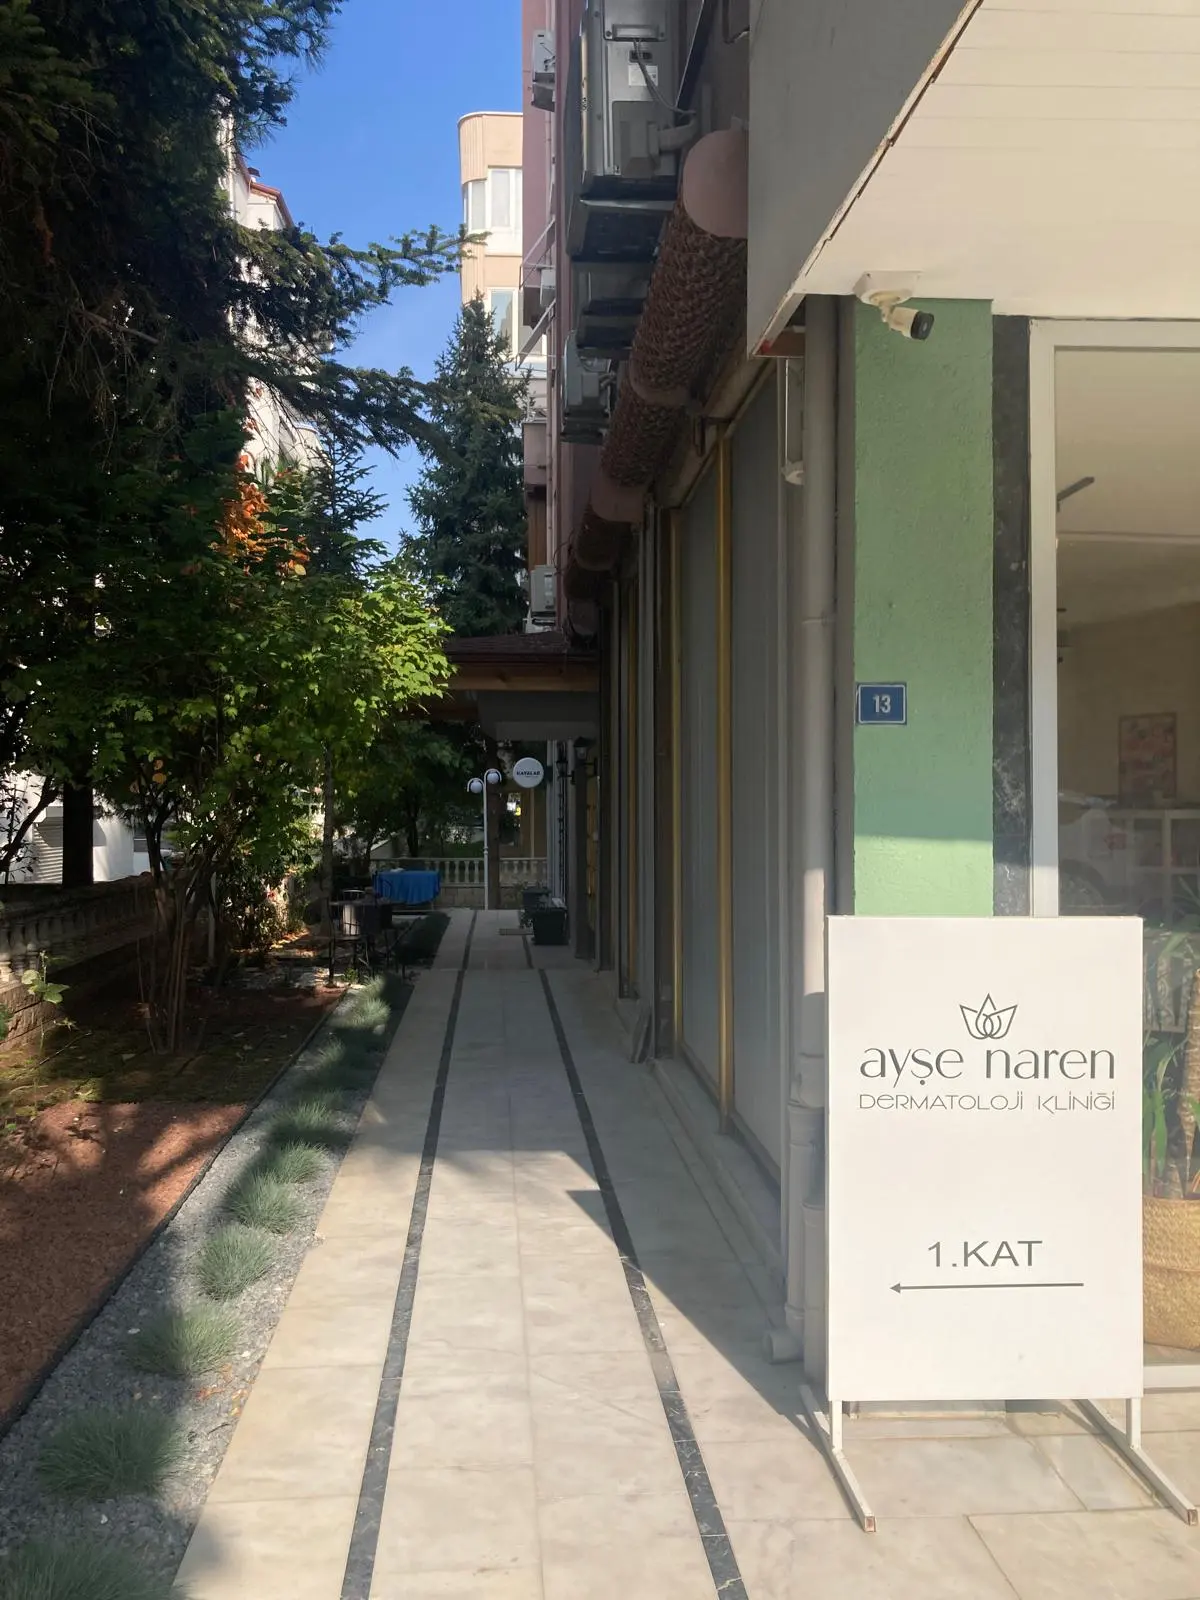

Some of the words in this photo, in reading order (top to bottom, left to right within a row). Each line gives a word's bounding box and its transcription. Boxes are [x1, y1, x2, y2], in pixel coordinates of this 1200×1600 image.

[872, 694, 891, 714] 13
[860, 1048, 965, 1088] ayşe
[985, 1048, 1115, 1080] naren
[928, 1240, 1043, 1268] 1.KAT
